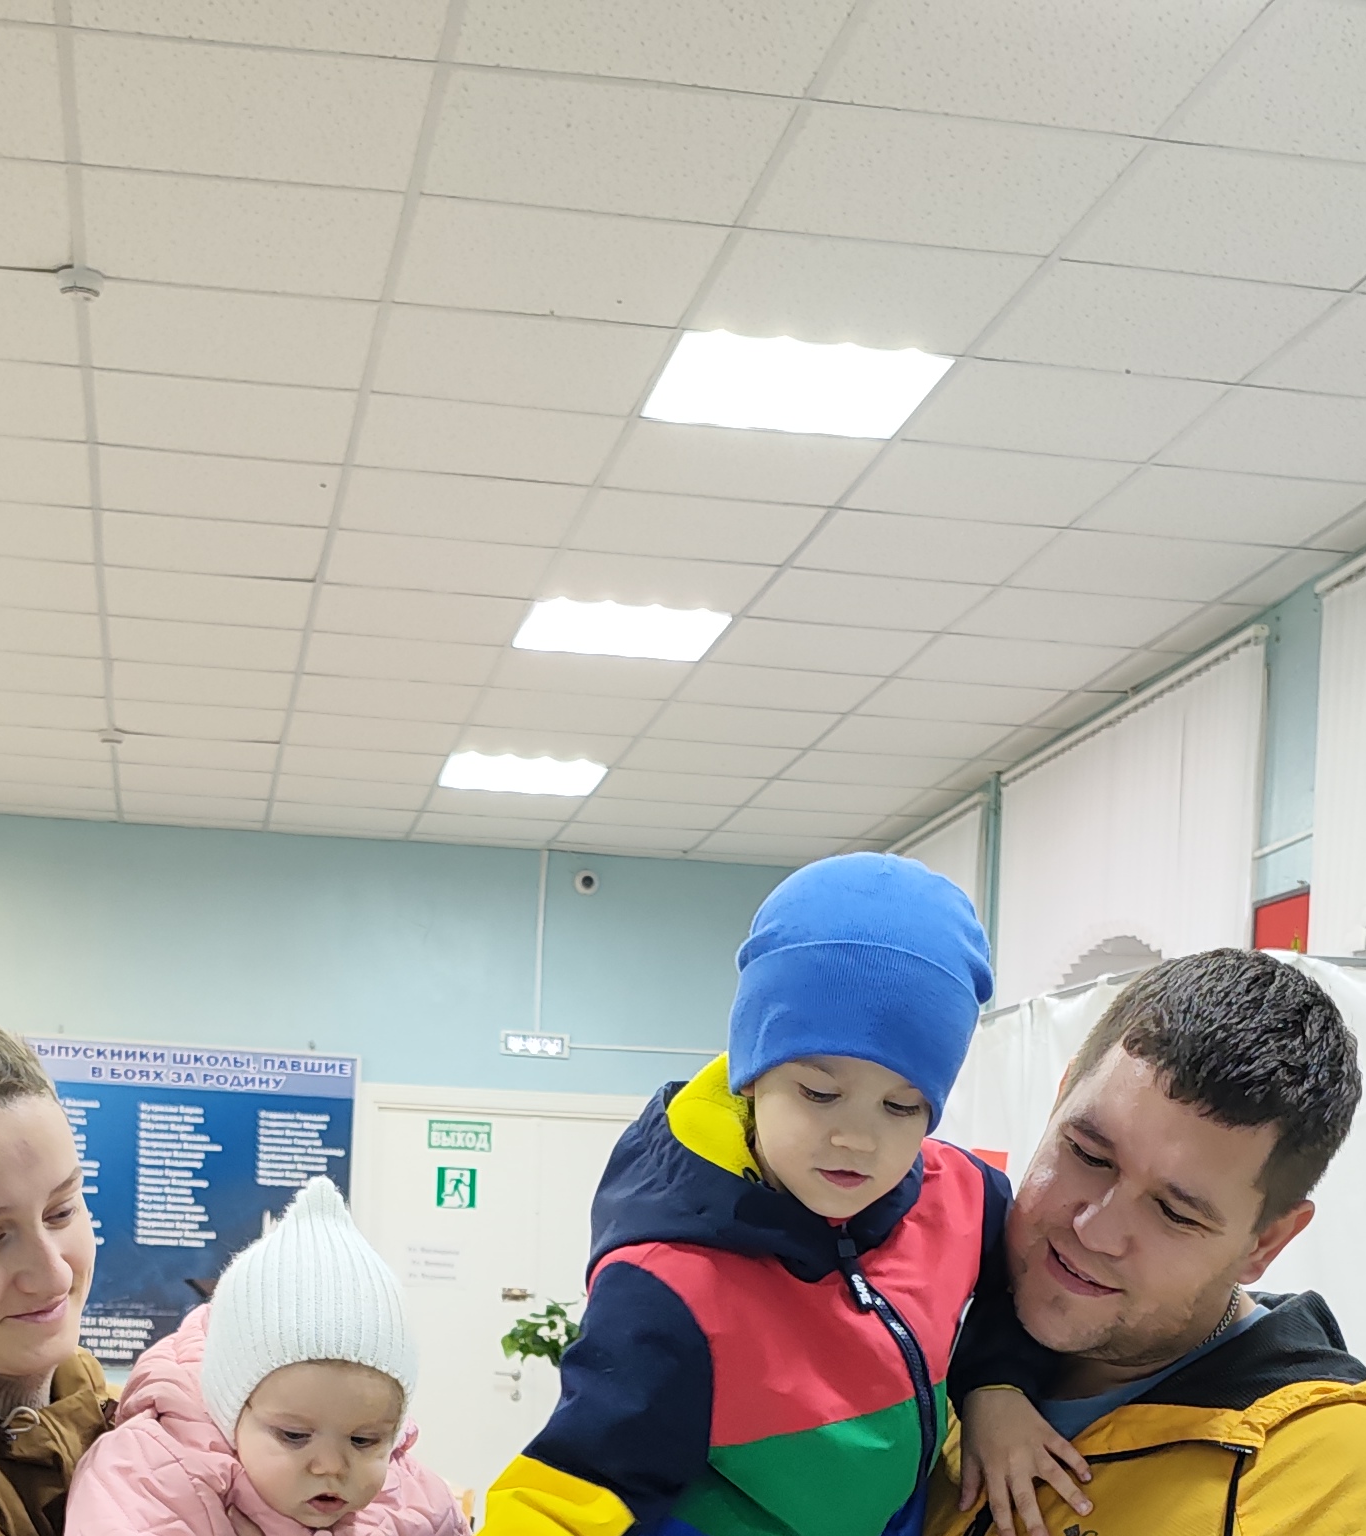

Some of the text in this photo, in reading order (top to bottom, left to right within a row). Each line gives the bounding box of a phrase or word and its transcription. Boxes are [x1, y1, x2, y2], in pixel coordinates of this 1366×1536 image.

[31, 1044, 165, 1064] ЫПУСКНИКИ
[263, 1058, 351, 1076] ПАВШИЕ
[91, 1067, 285, 1091] В БОЯХ ЗА РОДИНУ
[431, 1131, 490, 1151] ВЫХОД
